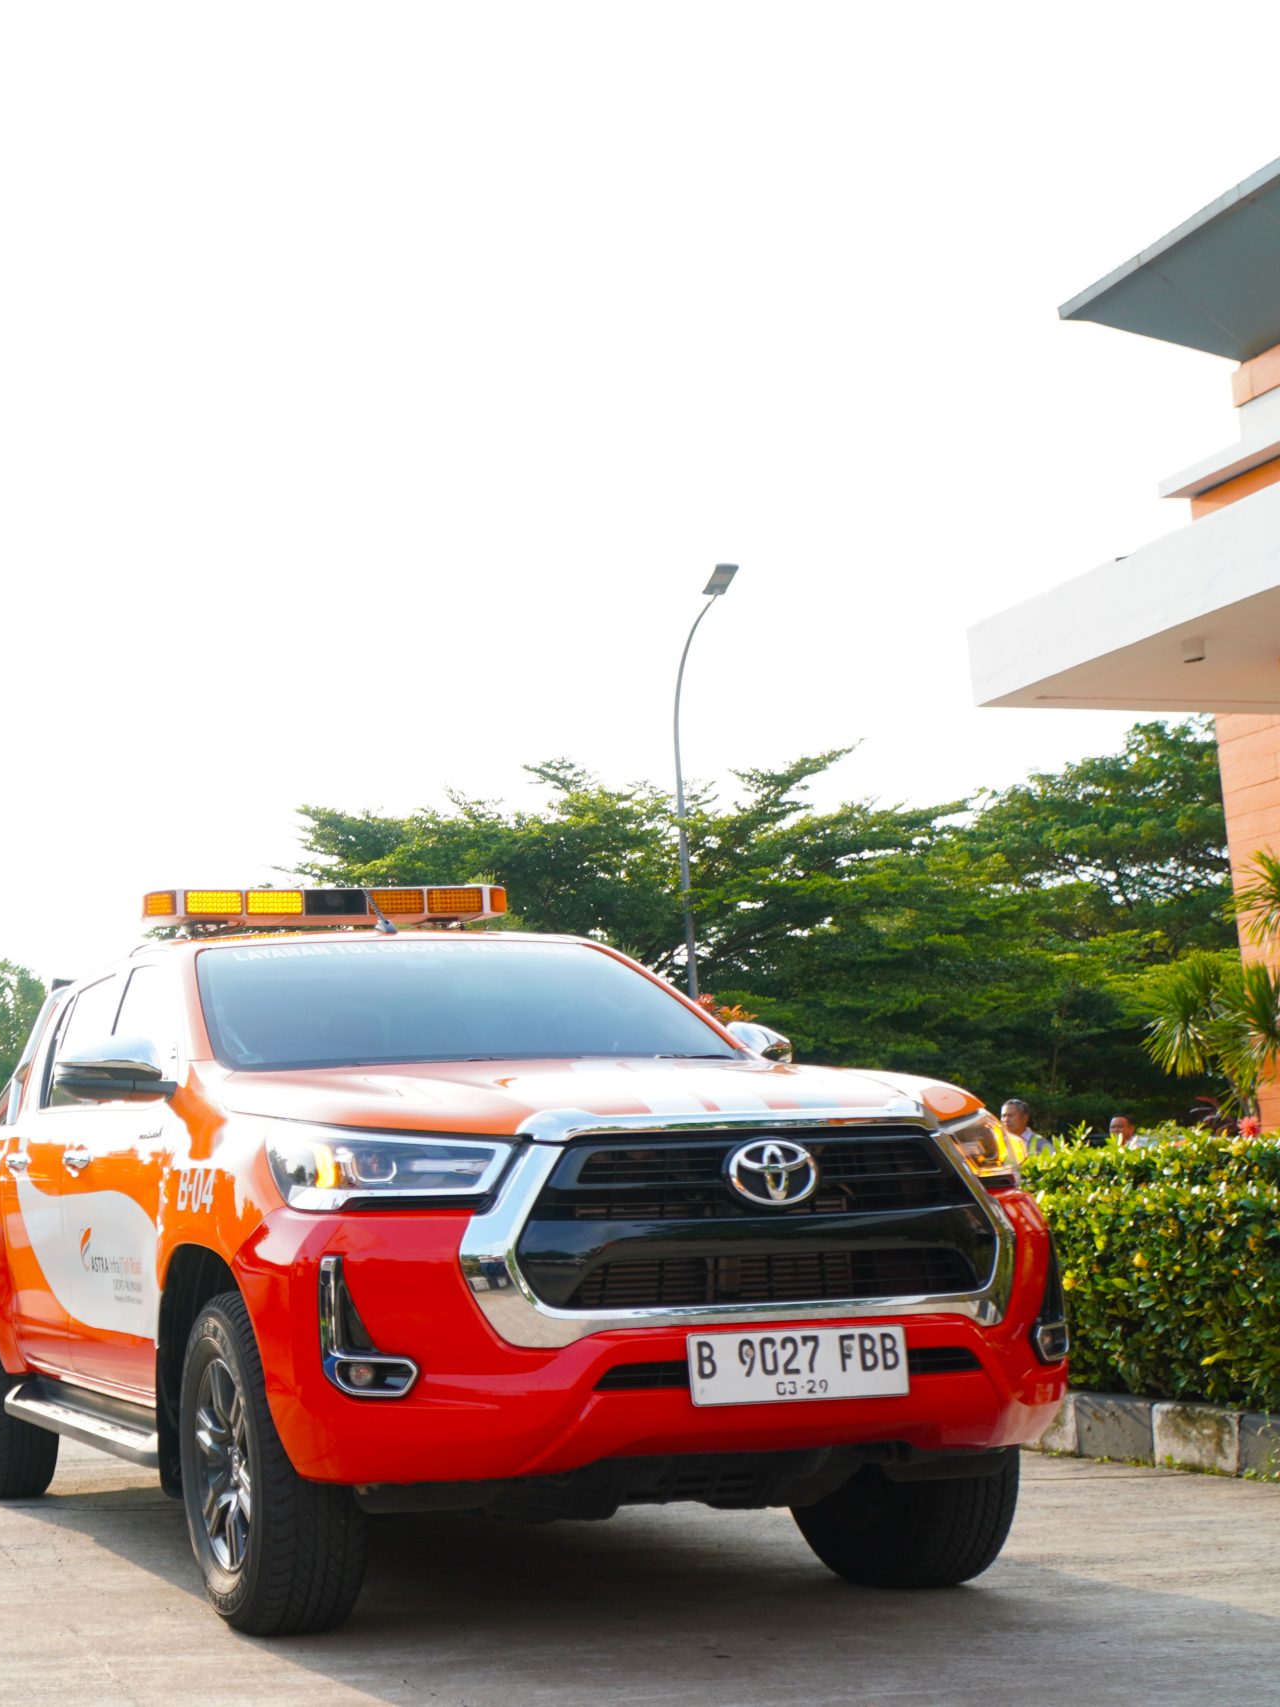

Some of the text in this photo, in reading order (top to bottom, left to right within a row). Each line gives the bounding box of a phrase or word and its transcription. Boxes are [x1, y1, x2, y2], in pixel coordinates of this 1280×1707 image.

[232, 942, 331, 962] LAYANAN
[333, 942, 376, 955] TOL
[177, 1167, 216, 1213] B-04
[91, 1256, 110, 1273] ASTRA
[696, 1332, 900, 1379] B 9027 FBB
